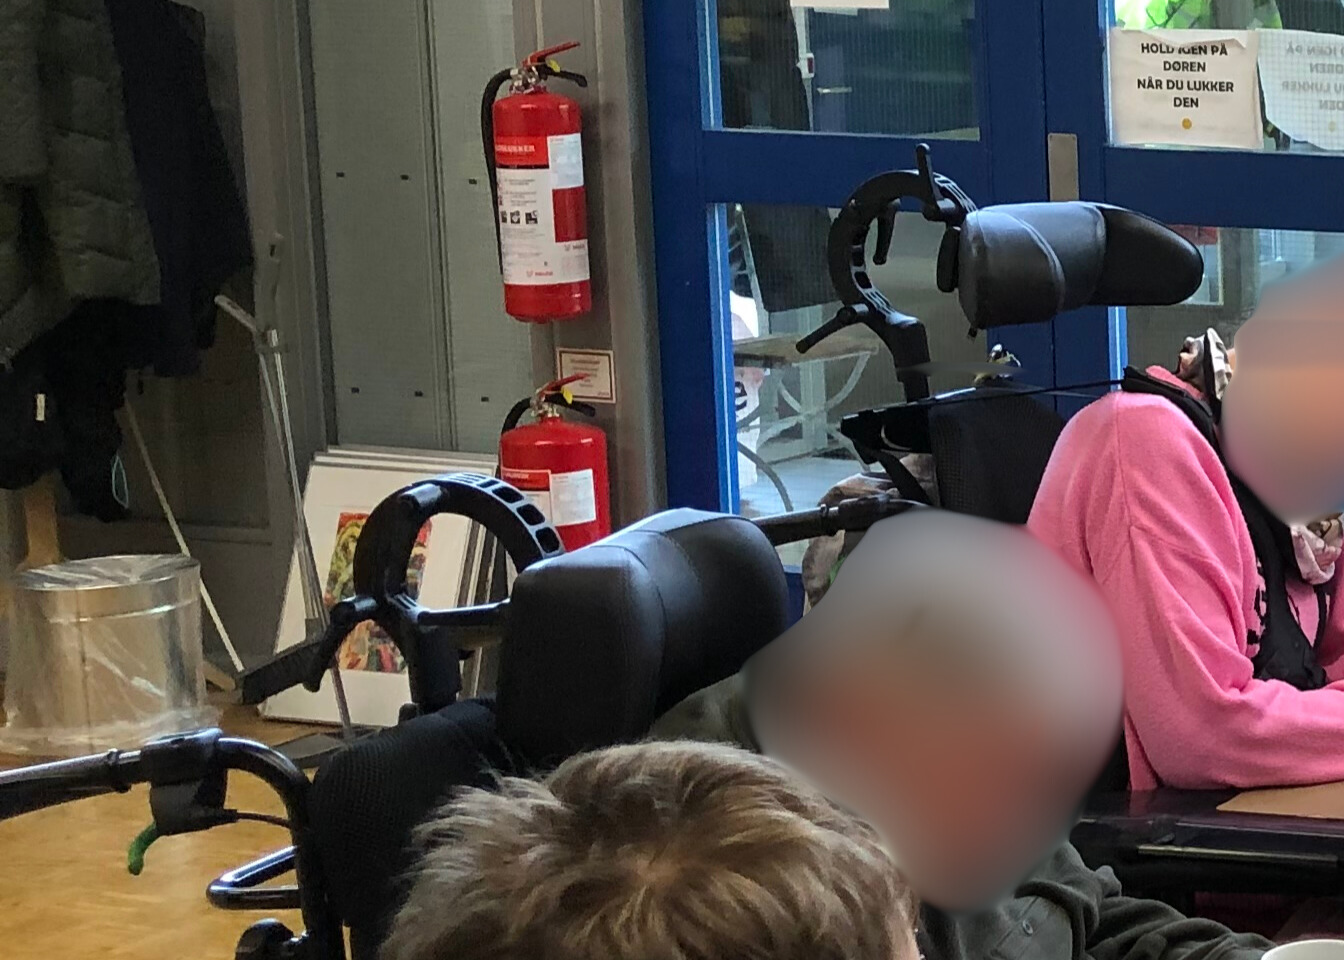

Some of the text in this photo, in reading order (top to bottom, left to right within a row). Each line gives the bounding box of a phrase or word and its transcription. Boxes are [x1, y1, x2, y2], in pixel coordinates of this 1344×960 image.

[1141, 43, 1174, 54] HOLD
[1211, 43, 1228, 56] PÅ
[1163, 60, 1206, 72] DØREN
[1137, 76, 1234, 92] NÅR DU LUKKER
[1173, 97, 1199, 108] DEN
